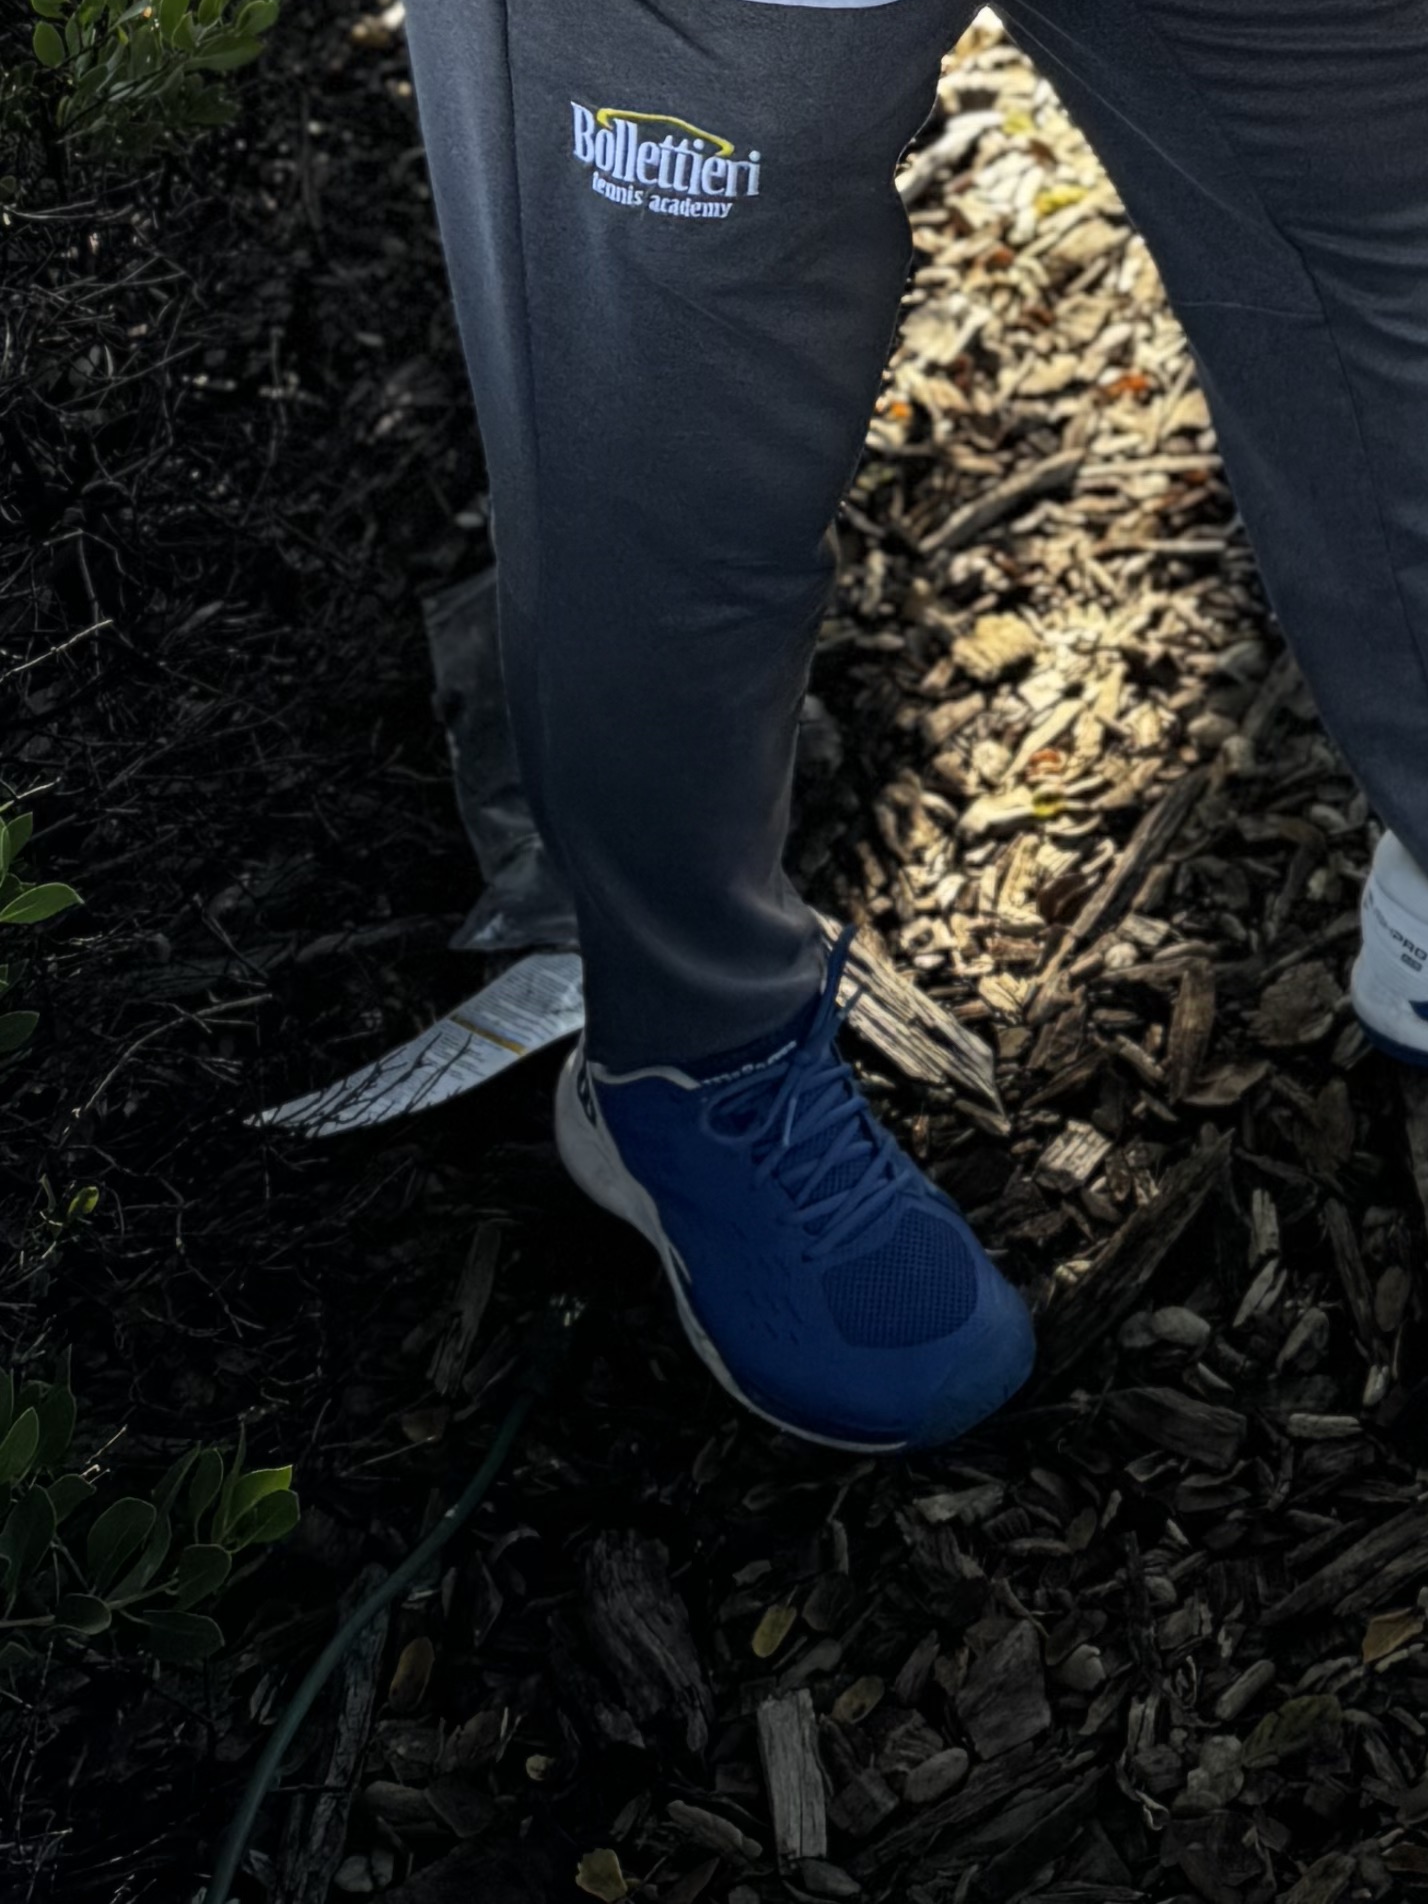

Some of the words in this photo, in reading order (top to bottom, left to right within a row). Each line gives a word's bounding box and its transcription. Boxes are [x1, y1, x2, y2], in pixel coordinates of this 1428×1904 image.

[571, 100, 761, 197] Bollettieri
[593, 172, 643, 207] tennis
[649, 193, 733, 218] academy
